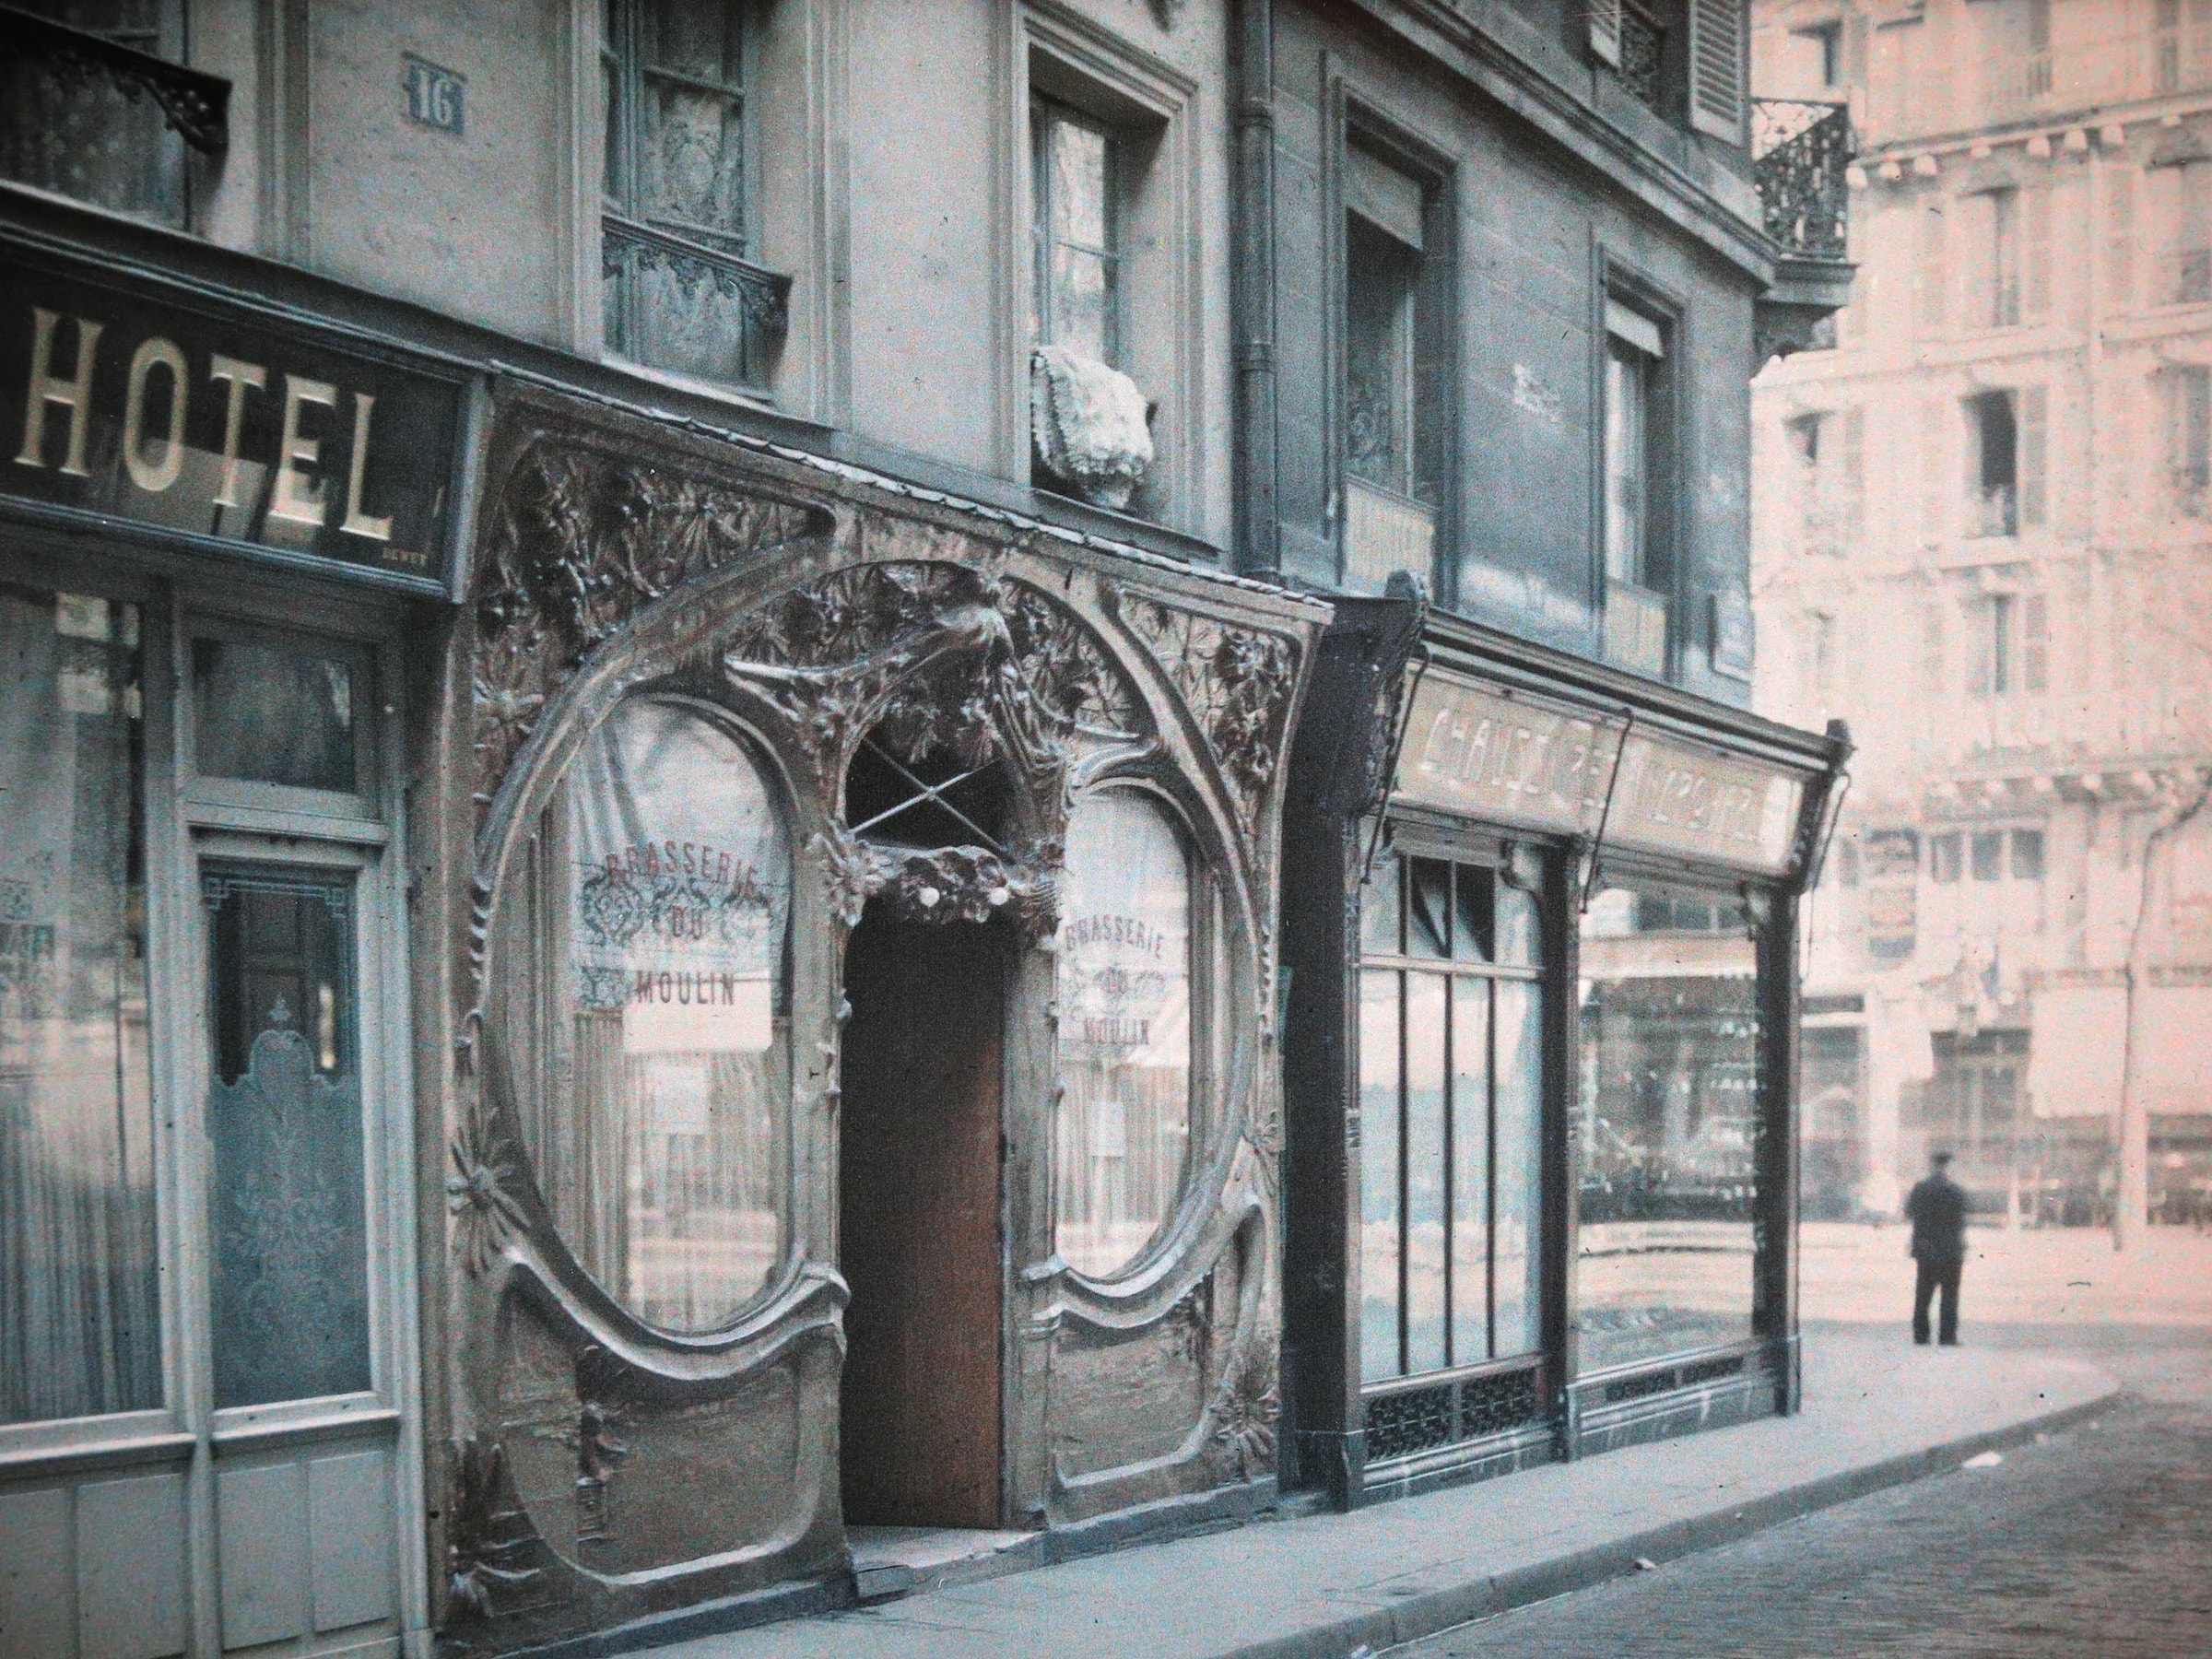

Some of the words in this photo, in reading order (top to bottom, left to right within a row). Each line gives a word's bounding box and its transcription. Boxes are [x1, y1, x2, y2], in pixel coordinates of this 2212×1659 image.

[418, 68, 453, 126] 16
[14, 306, 394, 541] HOTEL
[605, 840, 759, 902] BRASSERIE
[670, 904, 704, 940] DU
[636, 970, 735, 1006] MOULIN
